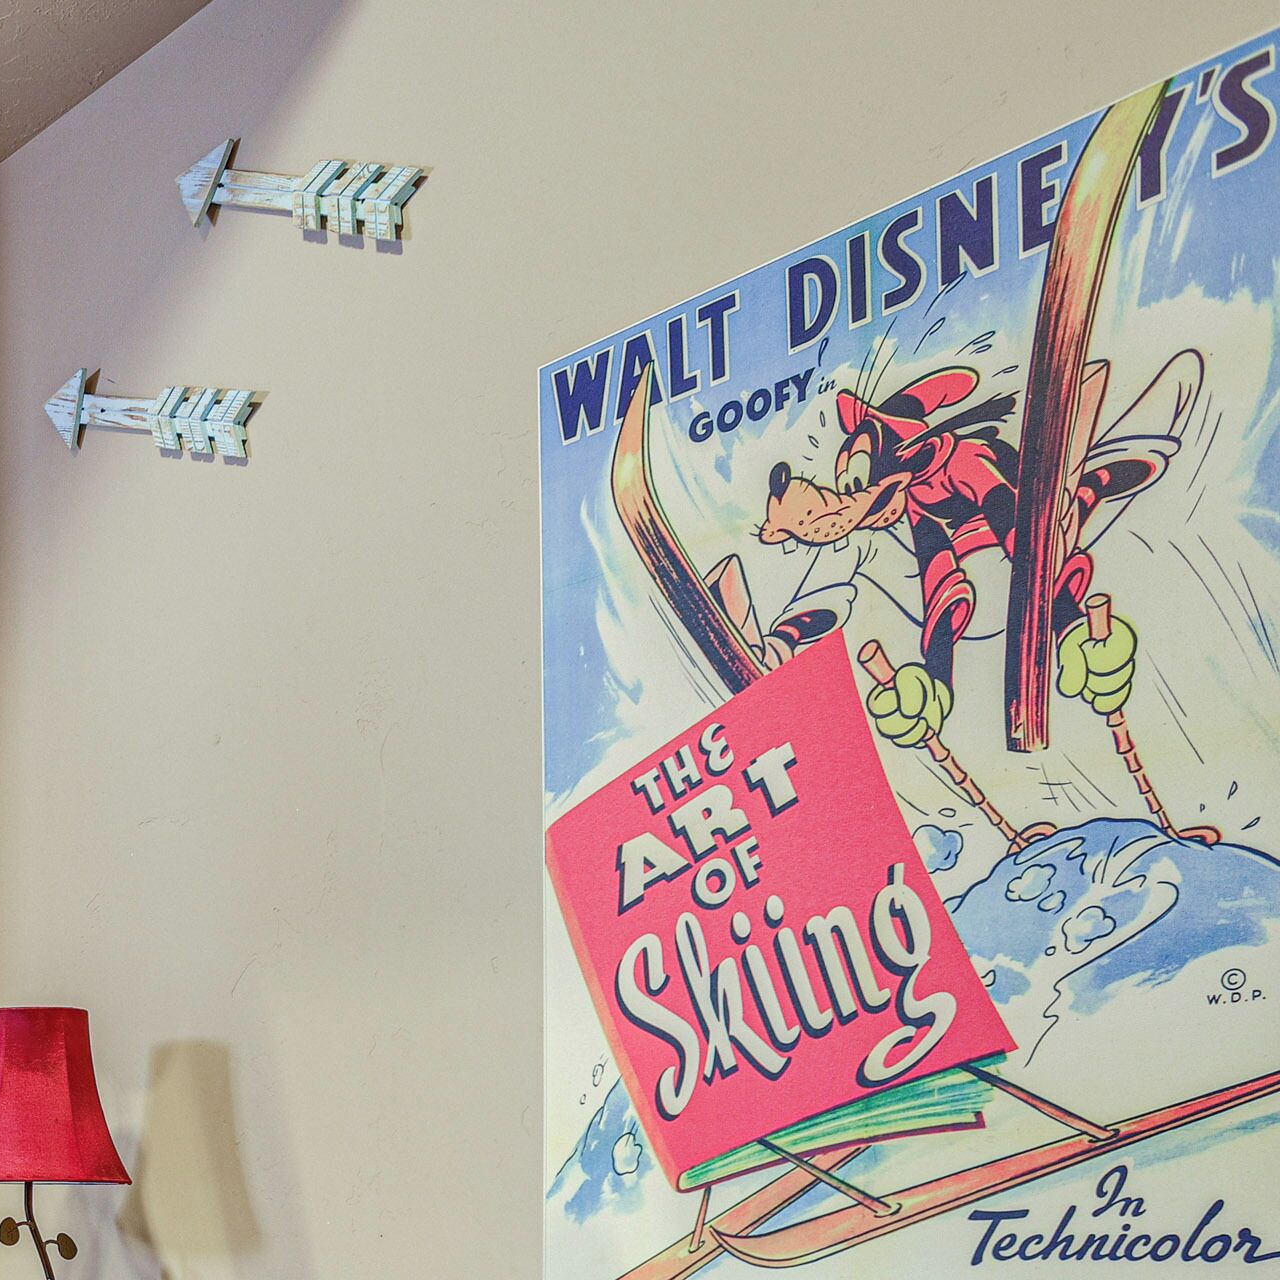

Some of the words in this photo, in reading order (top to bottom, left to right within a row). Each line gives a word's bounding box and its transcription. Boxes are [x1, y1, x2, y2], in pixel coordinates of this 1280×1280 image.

[552, 290, 739, 444] WALT
[689, 367, 816, 443] GOOFY
[817, 376, 838, 395] in
[630, 722, 736, 815] THE
[615, 742, 799, 916] ART
[691, 836, 763, 910] OF
[615, 863, 957, 1121] Skiing
[968, 1199, 1280, 1266] Technicolor
[1091, 1164, 1147, 1217] In
